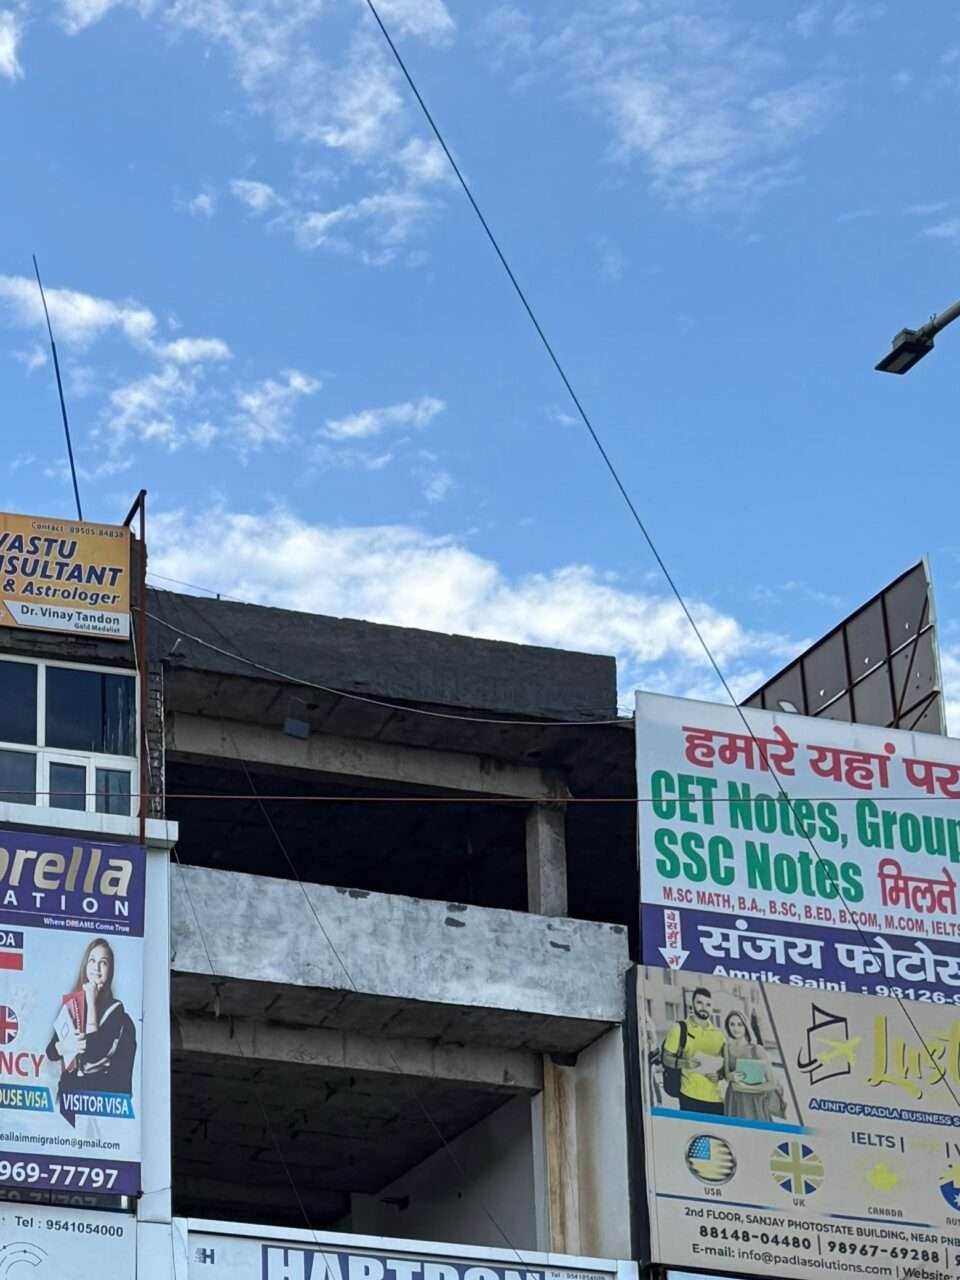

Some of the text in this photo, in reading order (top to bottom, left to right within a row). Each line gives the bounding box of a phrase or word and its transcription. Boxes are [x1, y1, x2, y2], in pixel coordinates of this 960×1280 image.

[3, 579, 120, 605] & Astrologer
[21, 605, 38, 616] Dr.
[40, 607, 74, 622] Vinay
[75, 610, 120, 625] Tandon
[681, 724, 896, 790] हमारे यहां
[650, 769, 849, 850] CET Notes,
[654, 827, 958, 916] SSC Notes मिलते
[697, 919, 825, 970] संजय
[25, 1090, 49, 1108] VISA
[62, 1093, 129, 1115] VISITOR VISA
[902, 1110, 952, 1125] BUSINESS
[851, 1131, 896, 1149] IELTS
[867, 1206, 904, 1218] CANADA
[15, 1215, 124, 1238] Tel 9541054000
[787, 1219, 939, 1245] PHOTOSTATE NEAR
[699, 1225, 940, 1264] 88148-04480 98967-69288
[737, 1248, 892, 1277] info@padlasolutions.com
